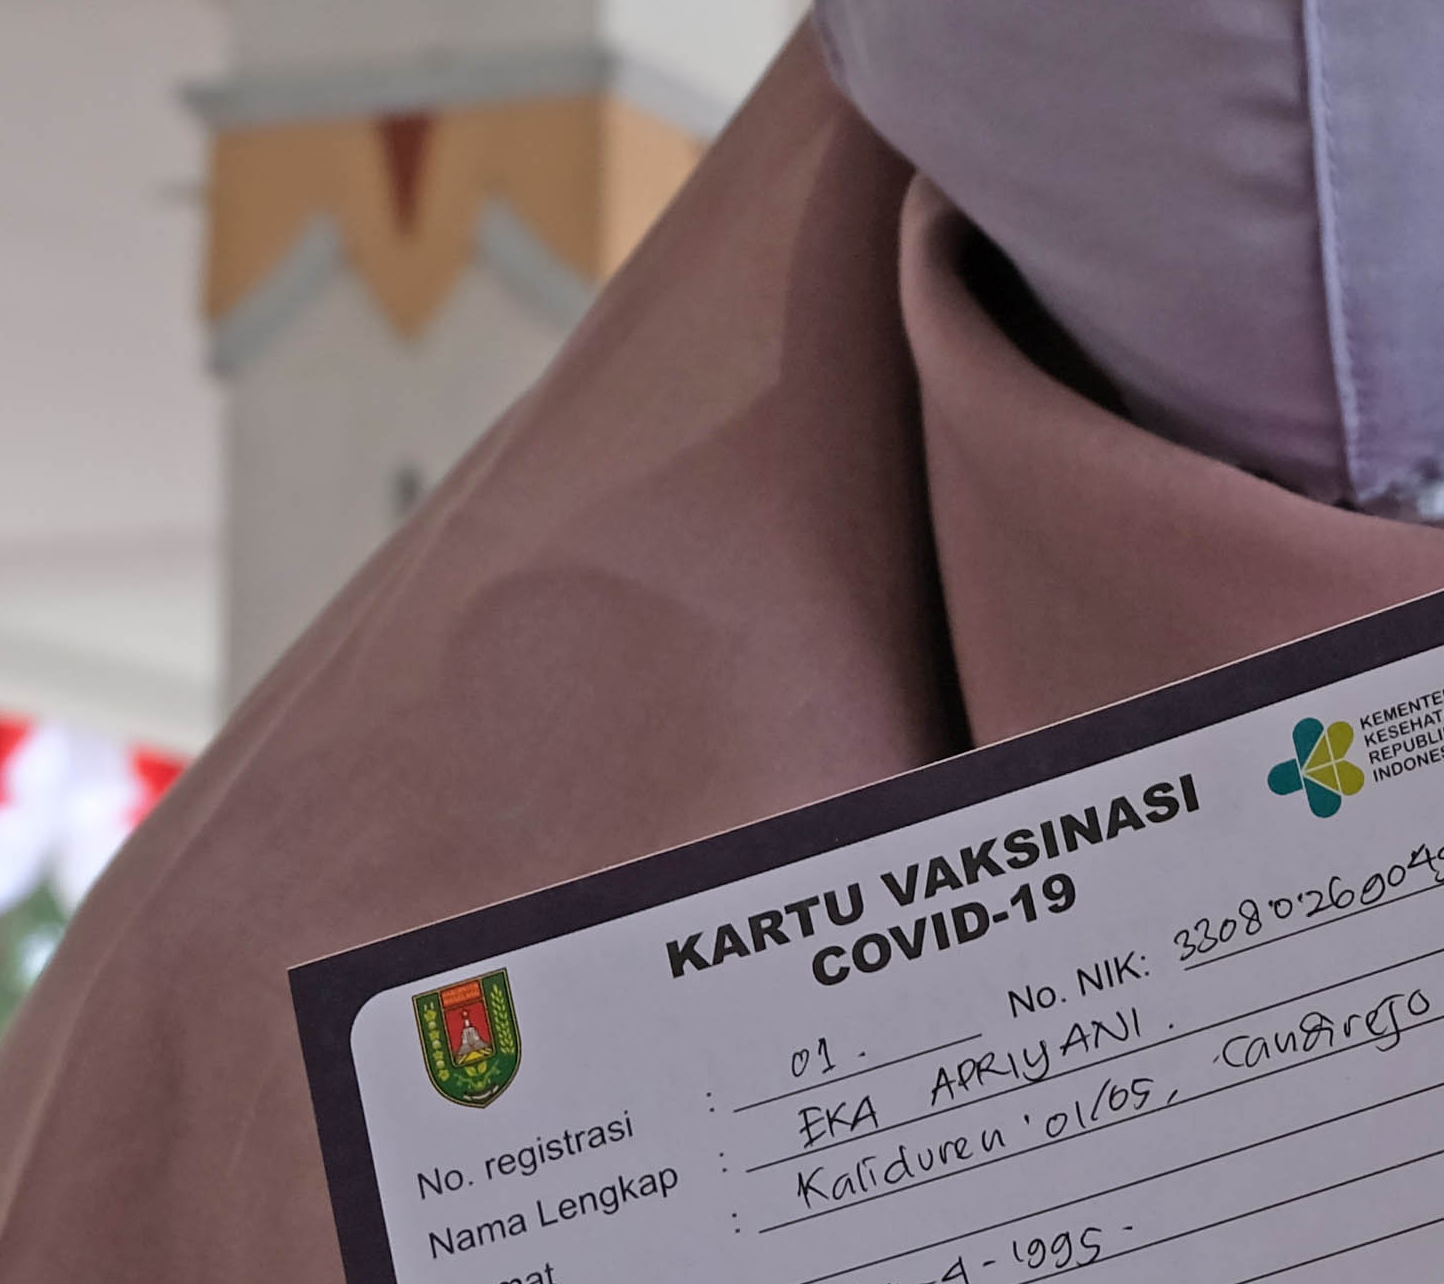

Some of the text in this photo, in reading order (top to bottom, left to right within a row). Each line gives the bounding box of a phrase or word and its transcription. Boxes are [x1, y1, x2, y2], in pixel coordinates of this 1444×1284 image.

[666, 773, 1200, 978] KARTU VAKSINASI
[812, 874, 1076, 985] COVID-19
[1008, 985, 1066, 1018] No.
[417, 1110, 634, 1199] No. registrasi
[798, 1095, 880, 1148] EKA
[429, 1168, 678, 1259] Nama Lengkap
